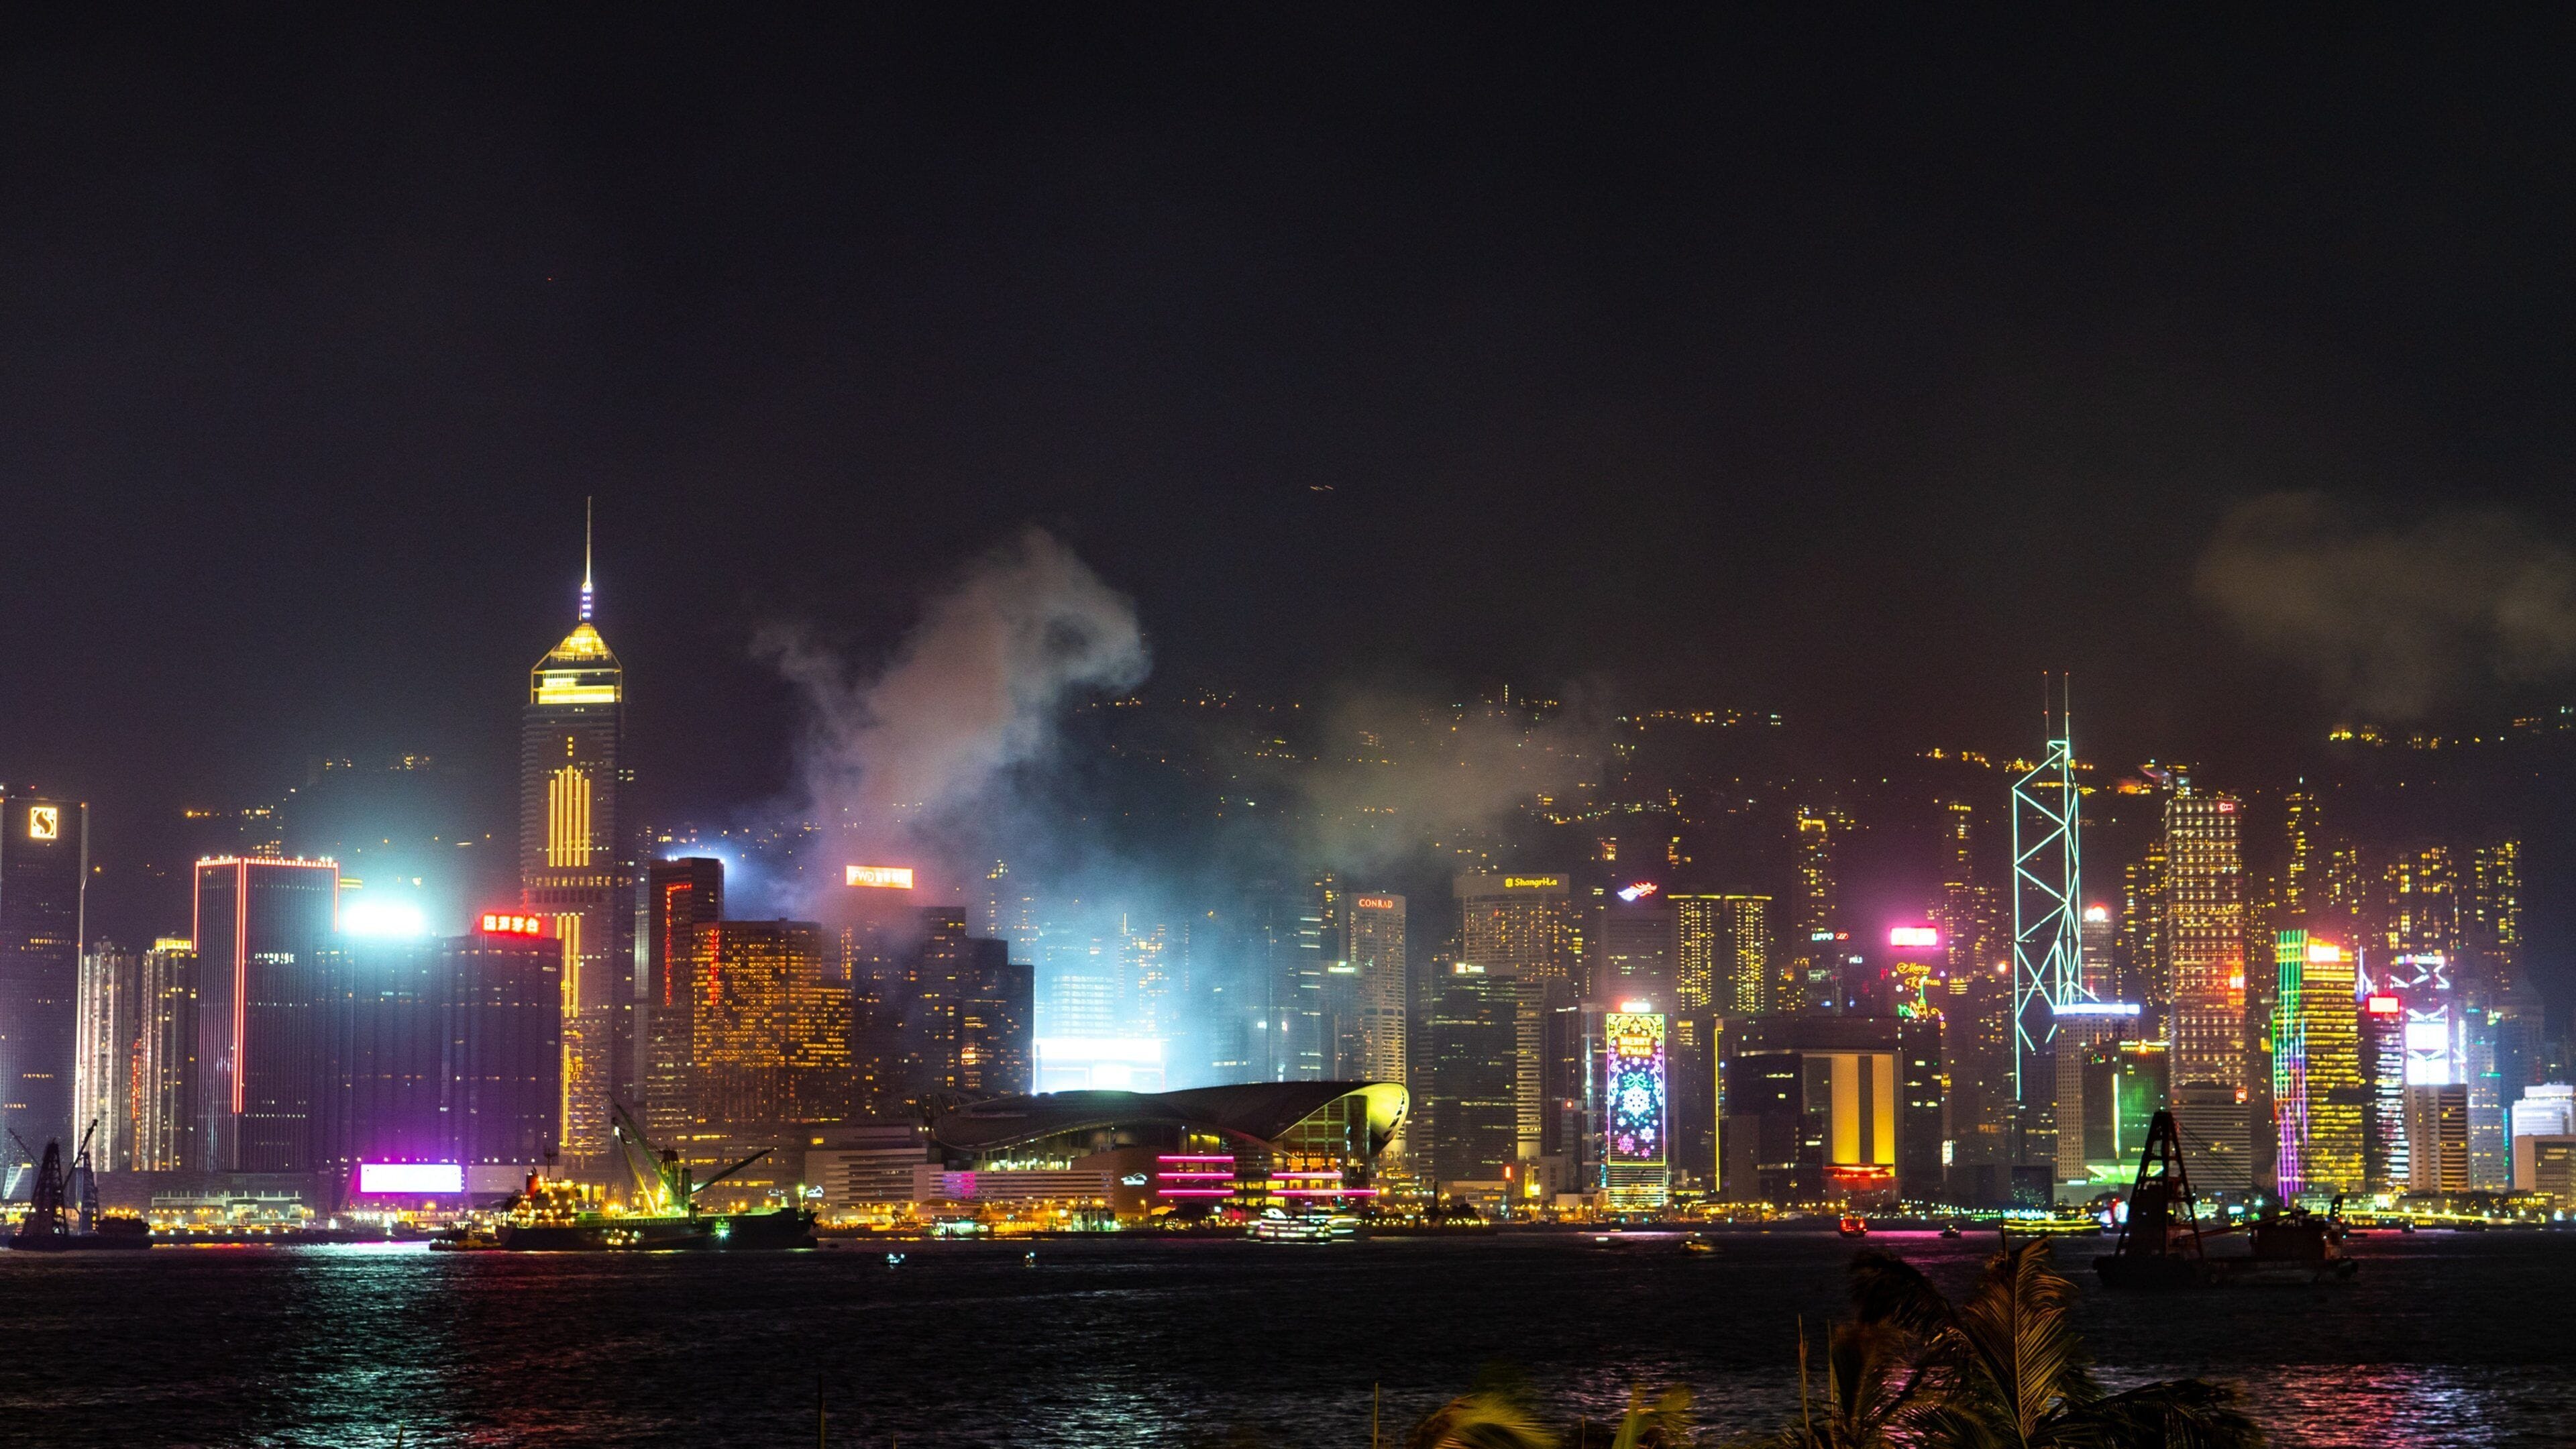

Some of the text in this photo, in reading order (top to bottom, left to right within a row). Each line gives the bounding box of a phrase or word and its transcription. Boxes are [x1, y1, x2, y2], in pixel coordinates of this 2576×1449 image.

[850, 870, 874, 882] FWD
[1514, 877, 1558, 888] Shangri-La
[1358, 898, 1393, 909] CONRAD
[1811, 932, 1834, 941] LIPPO
[1896, 962, 1931, 975] Merry
[1619, 1035, 1651, 1045] MERRY
